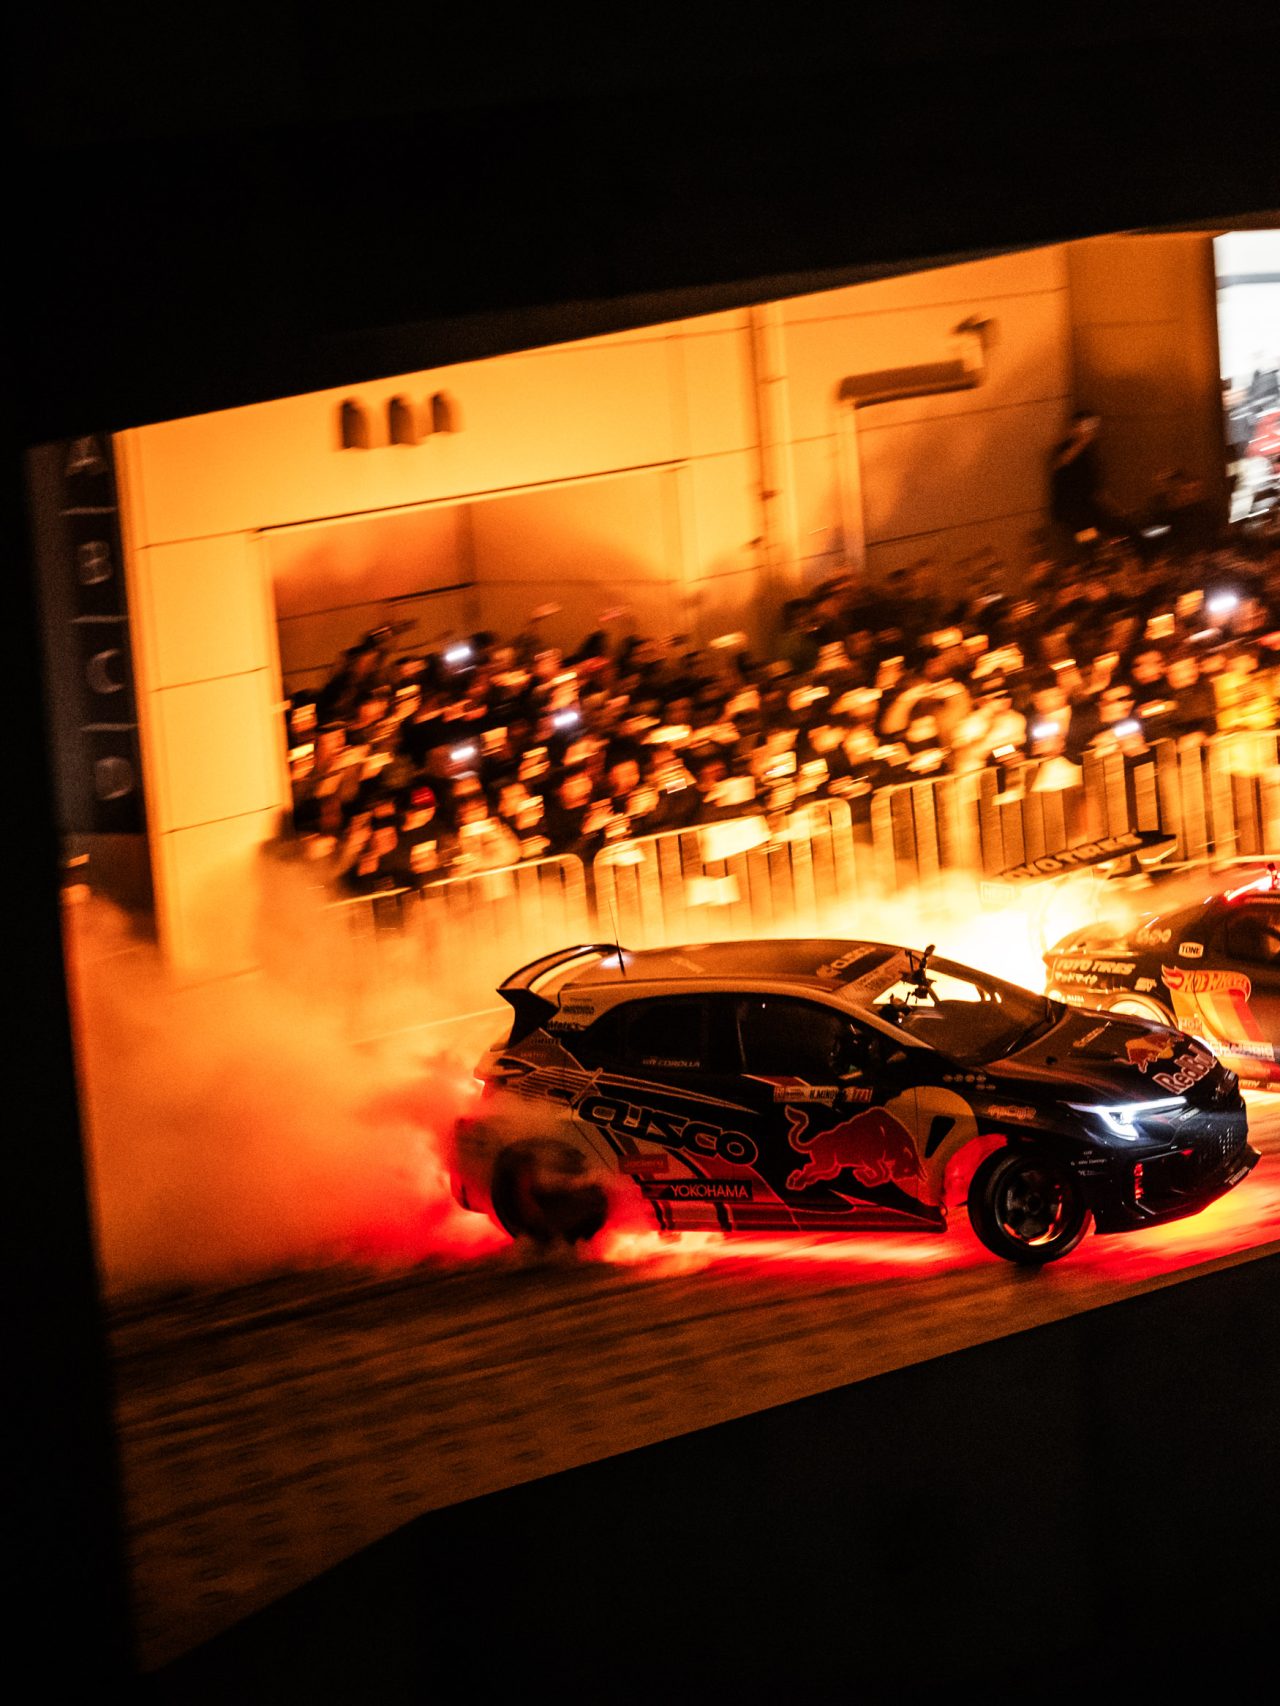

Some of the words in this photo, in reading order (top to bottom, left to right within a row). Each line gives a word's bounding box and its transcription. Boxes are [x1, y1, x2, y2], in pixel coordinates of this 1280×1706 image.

[87, 648, 124, 694] C
[1091, 959, 1137, 975] TIRES
[578, 1095, 759, 1166] CUSCO
[670, 1184, 749, 1199] YOKOHAMA
